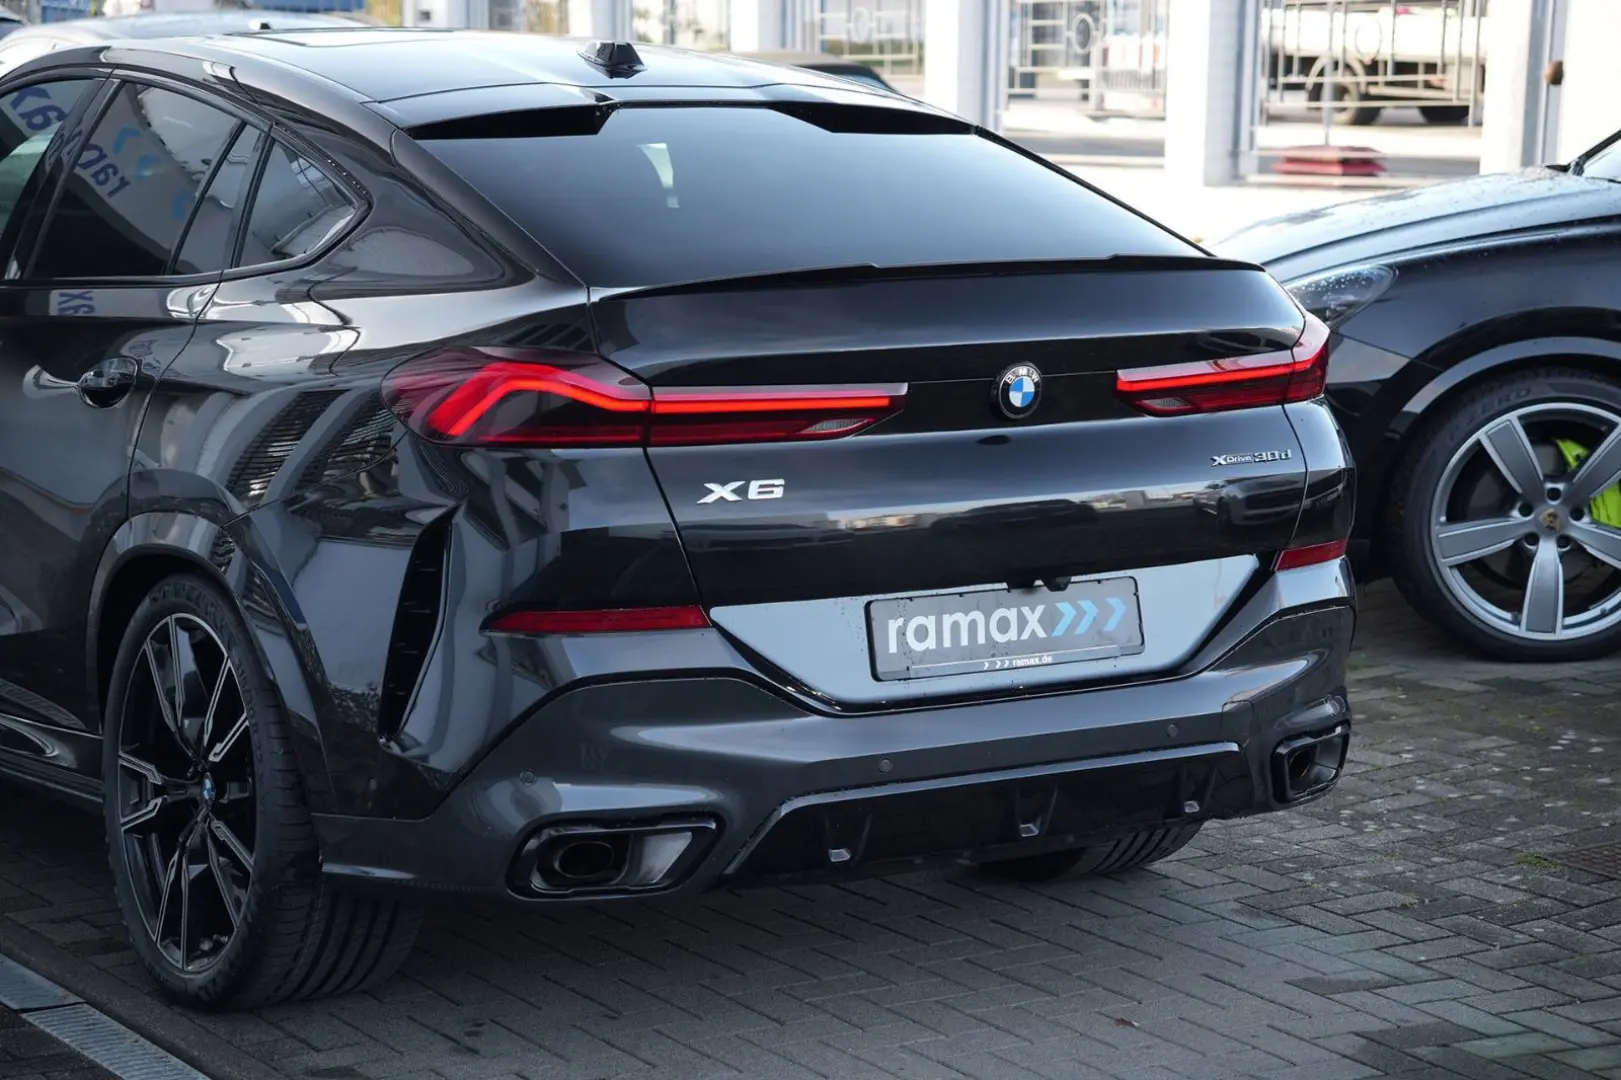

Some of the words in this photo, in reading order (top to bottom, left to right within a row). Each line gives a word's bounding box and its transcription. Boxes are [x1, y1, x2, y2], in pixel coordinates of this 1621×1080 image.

[1005, 367, 1040, 384] BMW
[697, 479, 785, 504] X6
[888, 604, 1048, 653] ramax
[1012, 655, 1053, 668] ramax.de
